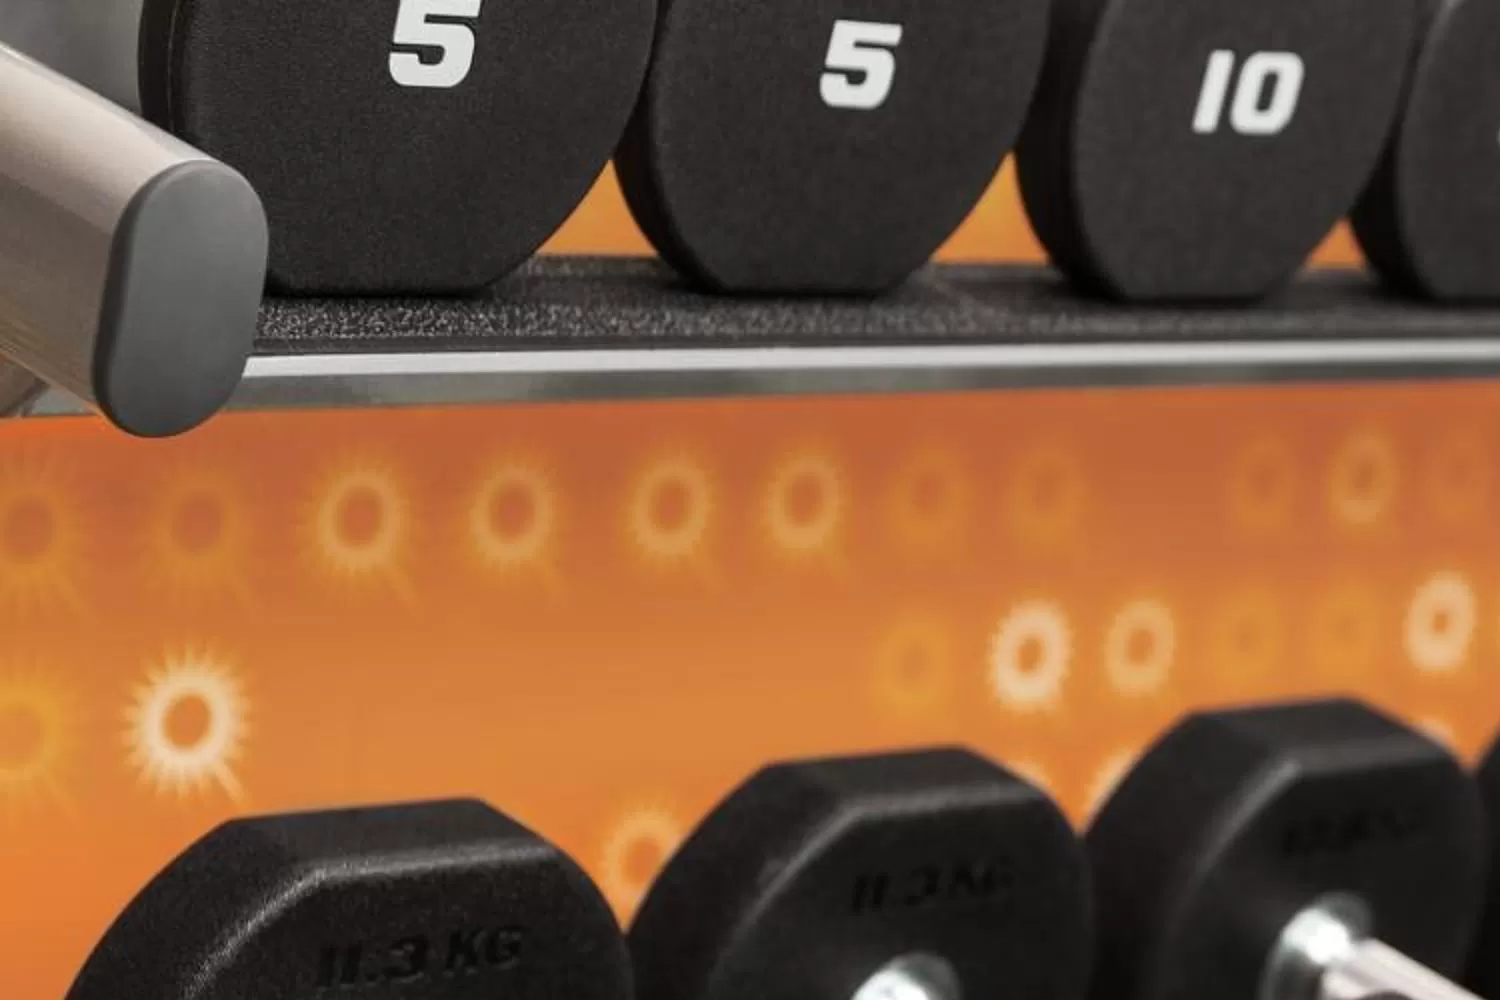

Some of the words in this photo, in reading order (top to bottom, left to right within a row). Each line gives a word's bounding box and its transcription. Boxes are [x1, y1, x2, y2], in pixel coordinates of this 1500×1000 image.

[389, 0, 481, 87] 5
[819, 19, 902, 109] 5
[1193, 49, 1304, 134] 10
